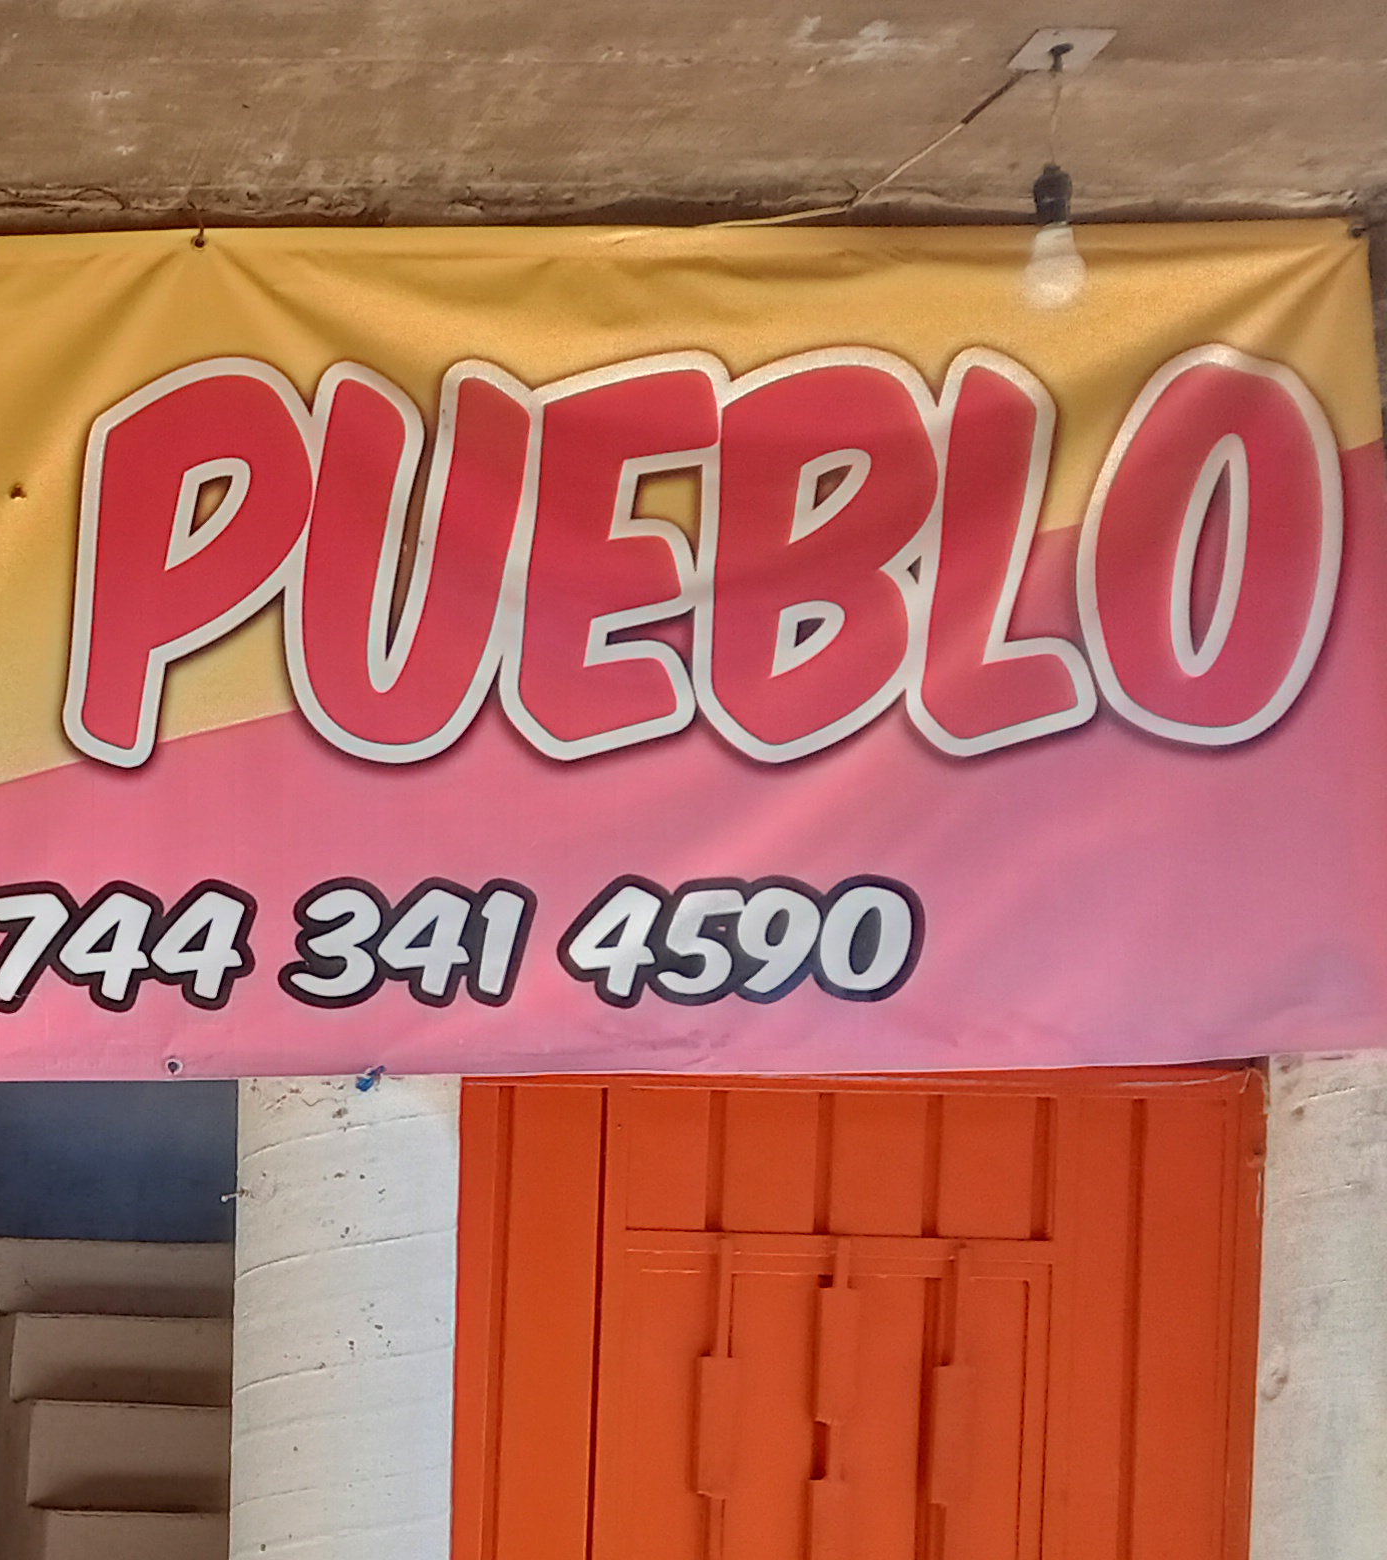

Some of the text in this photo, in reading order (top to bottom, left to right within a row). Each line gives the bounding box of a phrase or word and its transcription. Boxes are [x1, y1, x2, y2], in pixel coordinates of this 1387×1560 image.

[63, 345, 1343, 766] PUEBLO
[281, 875, 535, 1006] 341
[560, 875, 923, 1005] 4590
